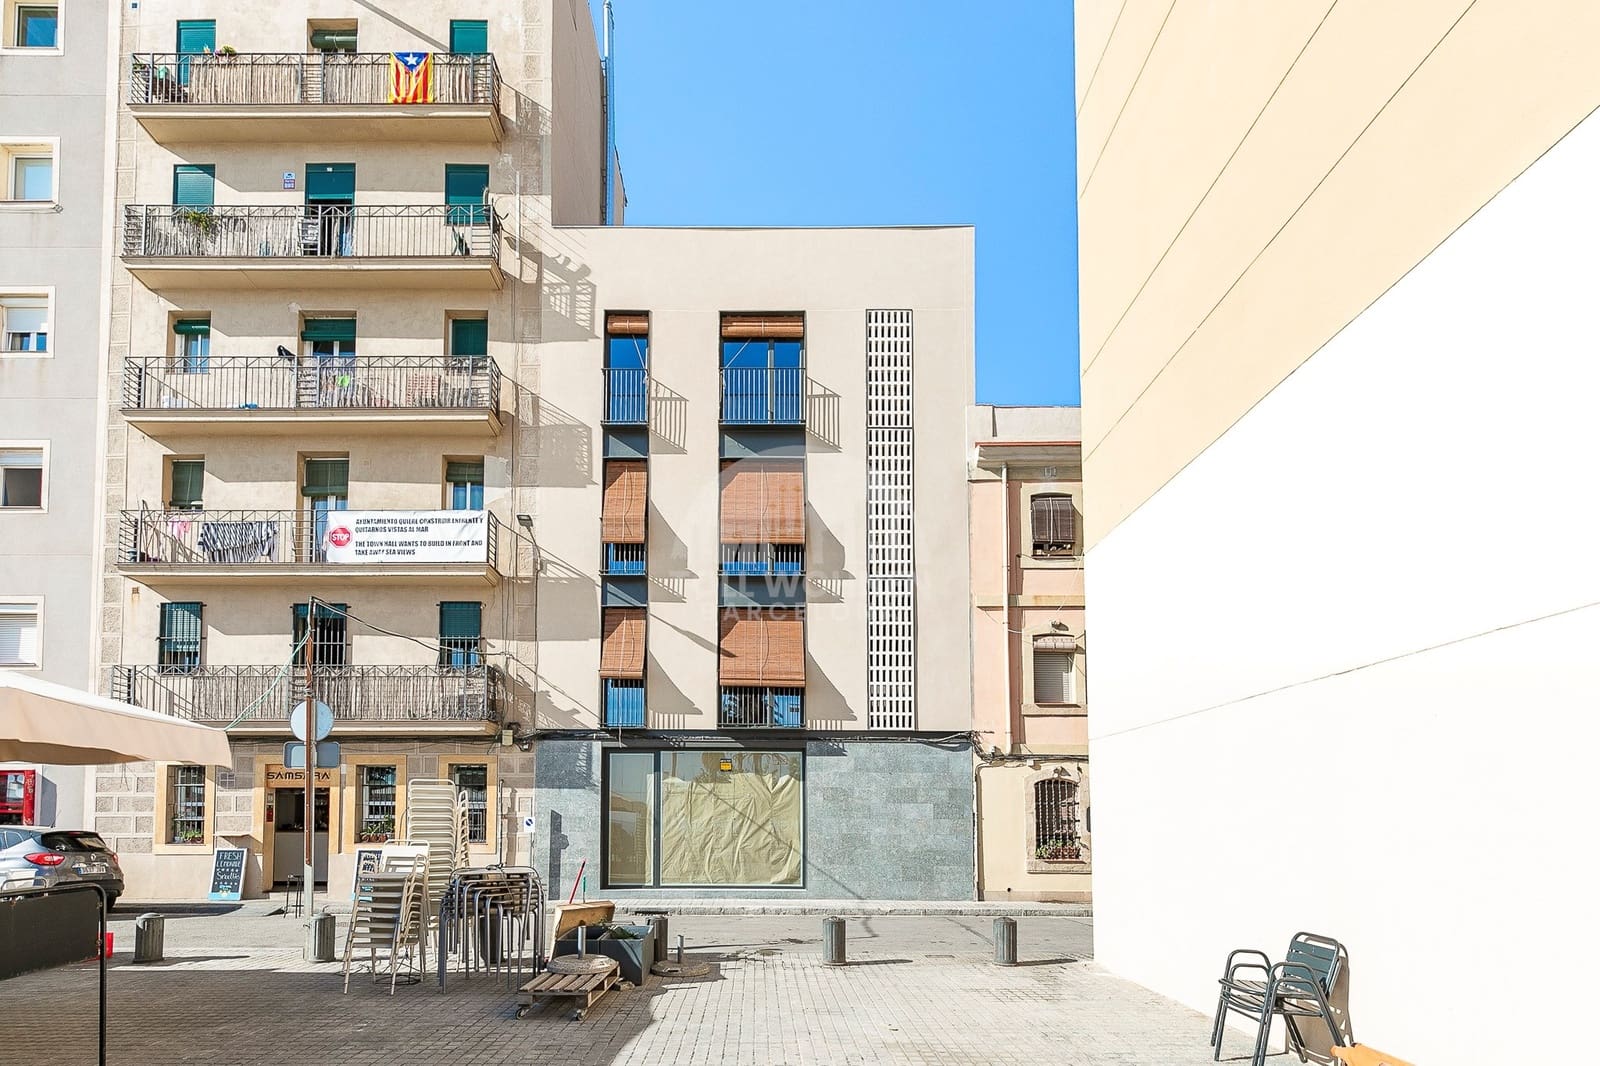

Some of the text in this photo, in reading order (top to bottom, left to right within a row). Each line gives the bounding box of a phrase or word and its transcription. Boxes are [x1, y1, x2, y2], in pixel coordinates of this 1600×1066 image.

[332, 533, 350, 541] STOP
[266, 771, 330, 780] SAMSRA
[219, 851, 242, 860] FRESH
